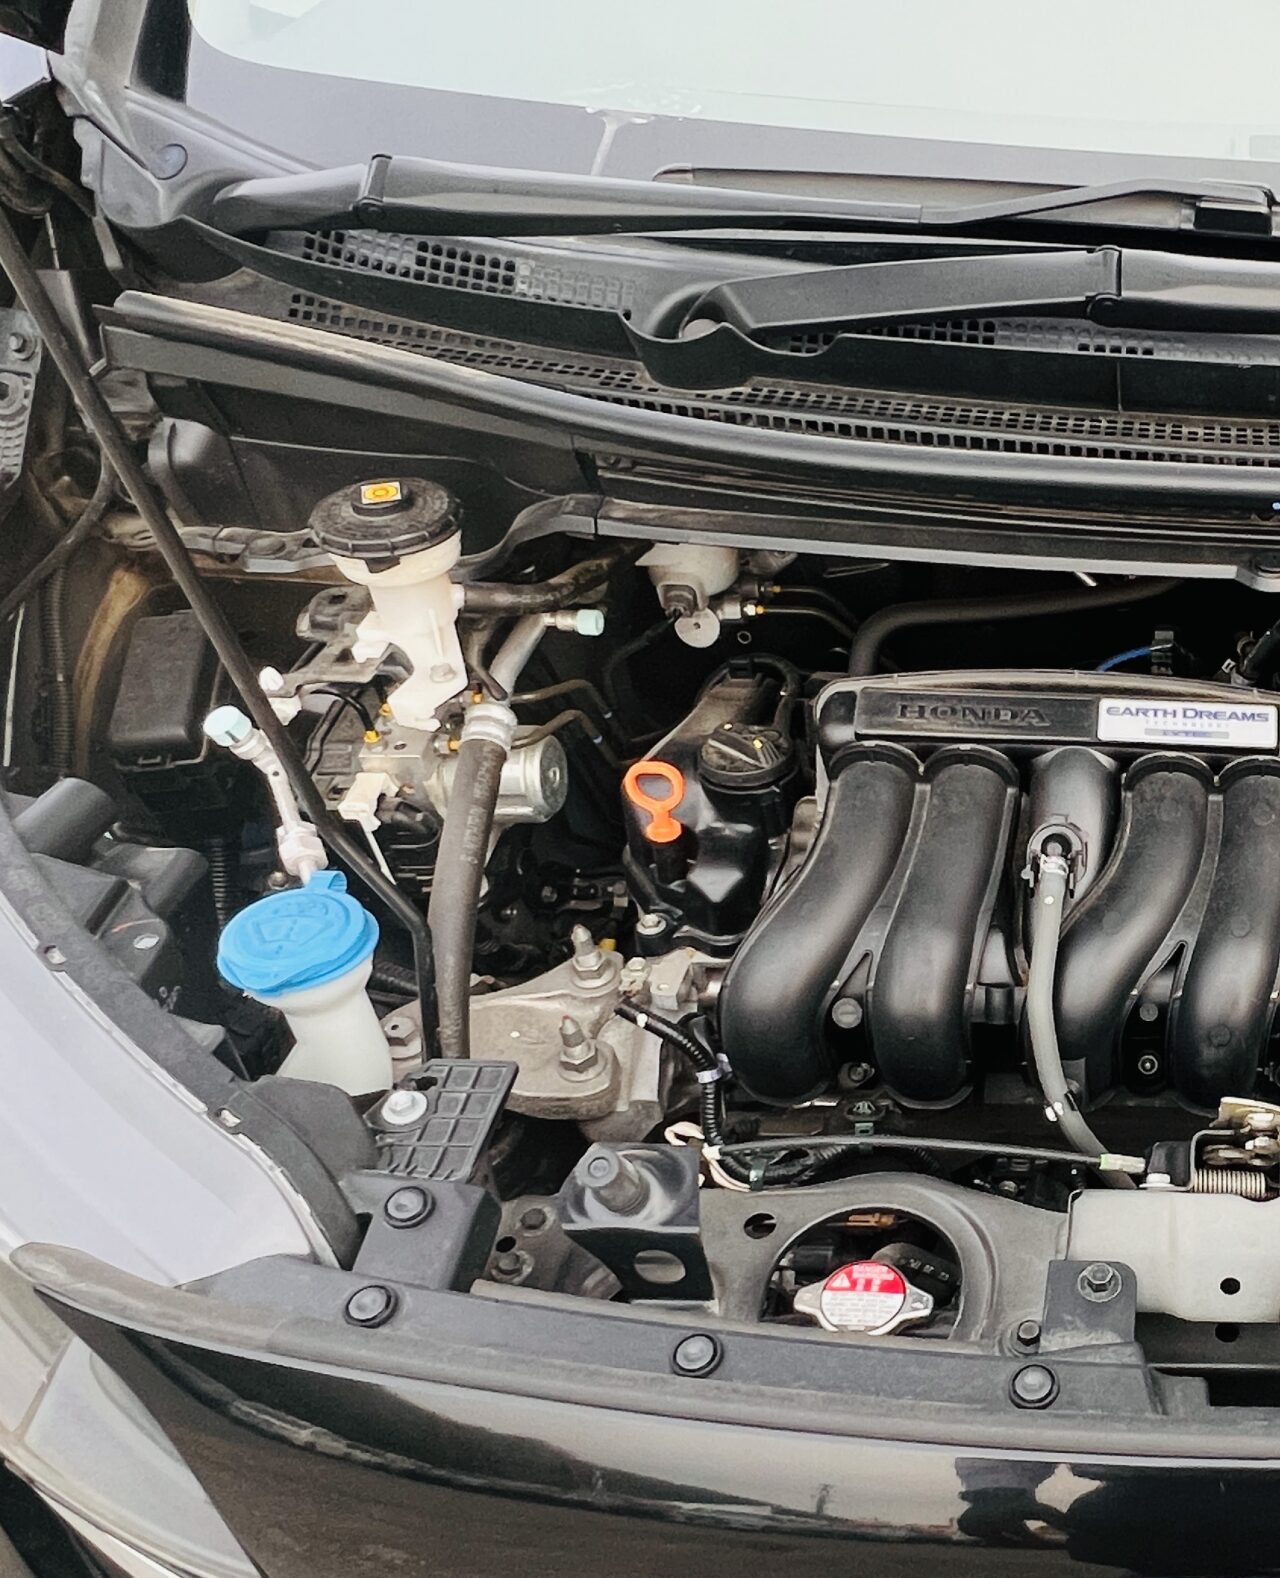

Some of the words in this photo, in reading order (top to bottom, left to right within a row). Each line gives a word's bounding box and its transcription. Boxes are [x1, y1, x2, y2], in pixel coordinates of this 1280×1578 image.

[896, 703, 1051, 727] HONDA
[1106, 706, 1177, 719] EARTH
[1182, 707, 1270, 723] DREAMS
